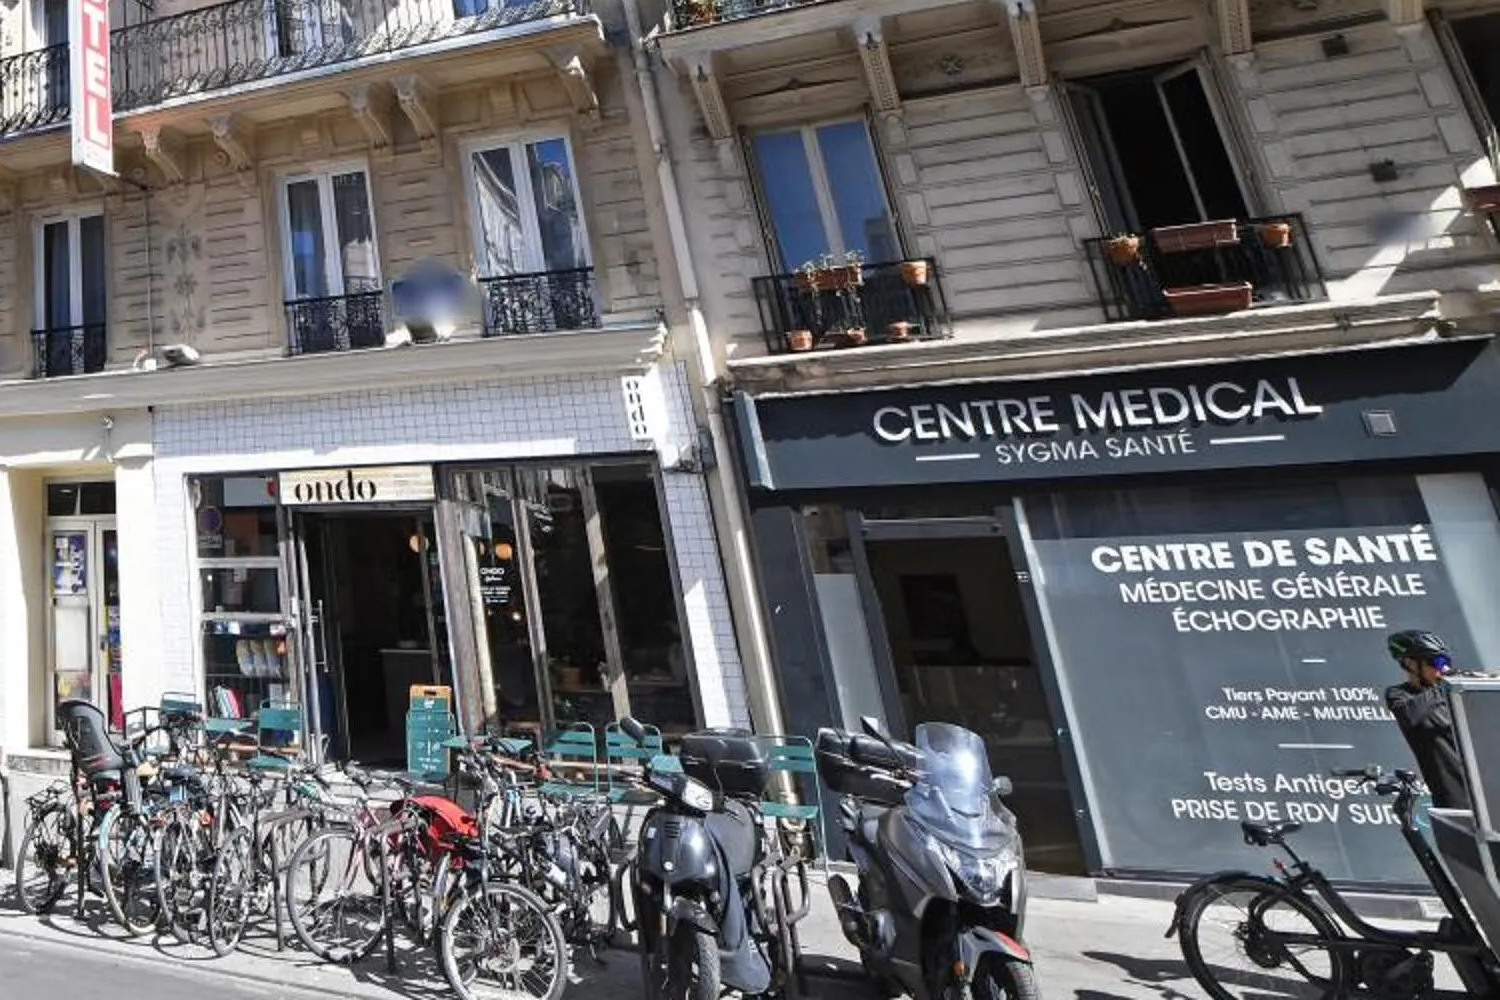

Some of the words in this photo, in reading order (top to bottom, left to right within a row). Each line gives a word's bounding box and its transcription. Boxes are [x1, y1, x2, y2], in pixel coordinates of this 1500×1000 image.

[626, 380, 647, 435] ondo
[873, 395, 1059, 441] CENTRE
[1071, 377, 1323, 431] MEDICAL
[994, 438, 1099, 465] SYGMA
[1105, 427, 1197, 459] SANTÉ
[294, 469, 377, 501] ondo
[1091, 541, 1234, 573] CENTRE
[1242, 538, 1297, 567] DE
[1307, 524, 1438, 566] SANTÉ
[1118, 577, 1265, 603] MÉDECINE
[1271, 571, 1426, 600] GÉNÉRALE
[1172, 606, 1387, 632] ÉCHOGRAPHIE
[1221, 687, 1262, 702] Tiers
[1265, 687, 1326, 704] Payant
[1331, 687, 1379, 701] 100%
[1205, 706, 1247, 720] CMU
[1261, 706, 1300, 720] AME
[1313, 706, 1396, 721] MUTUELL
[1204, 772, 1267, 793] Tests
[1171, 799, 1239, 822] PRISE
[1243, 800, 1281, 822] DE
[1286, 801, 1340, 823] RDV
